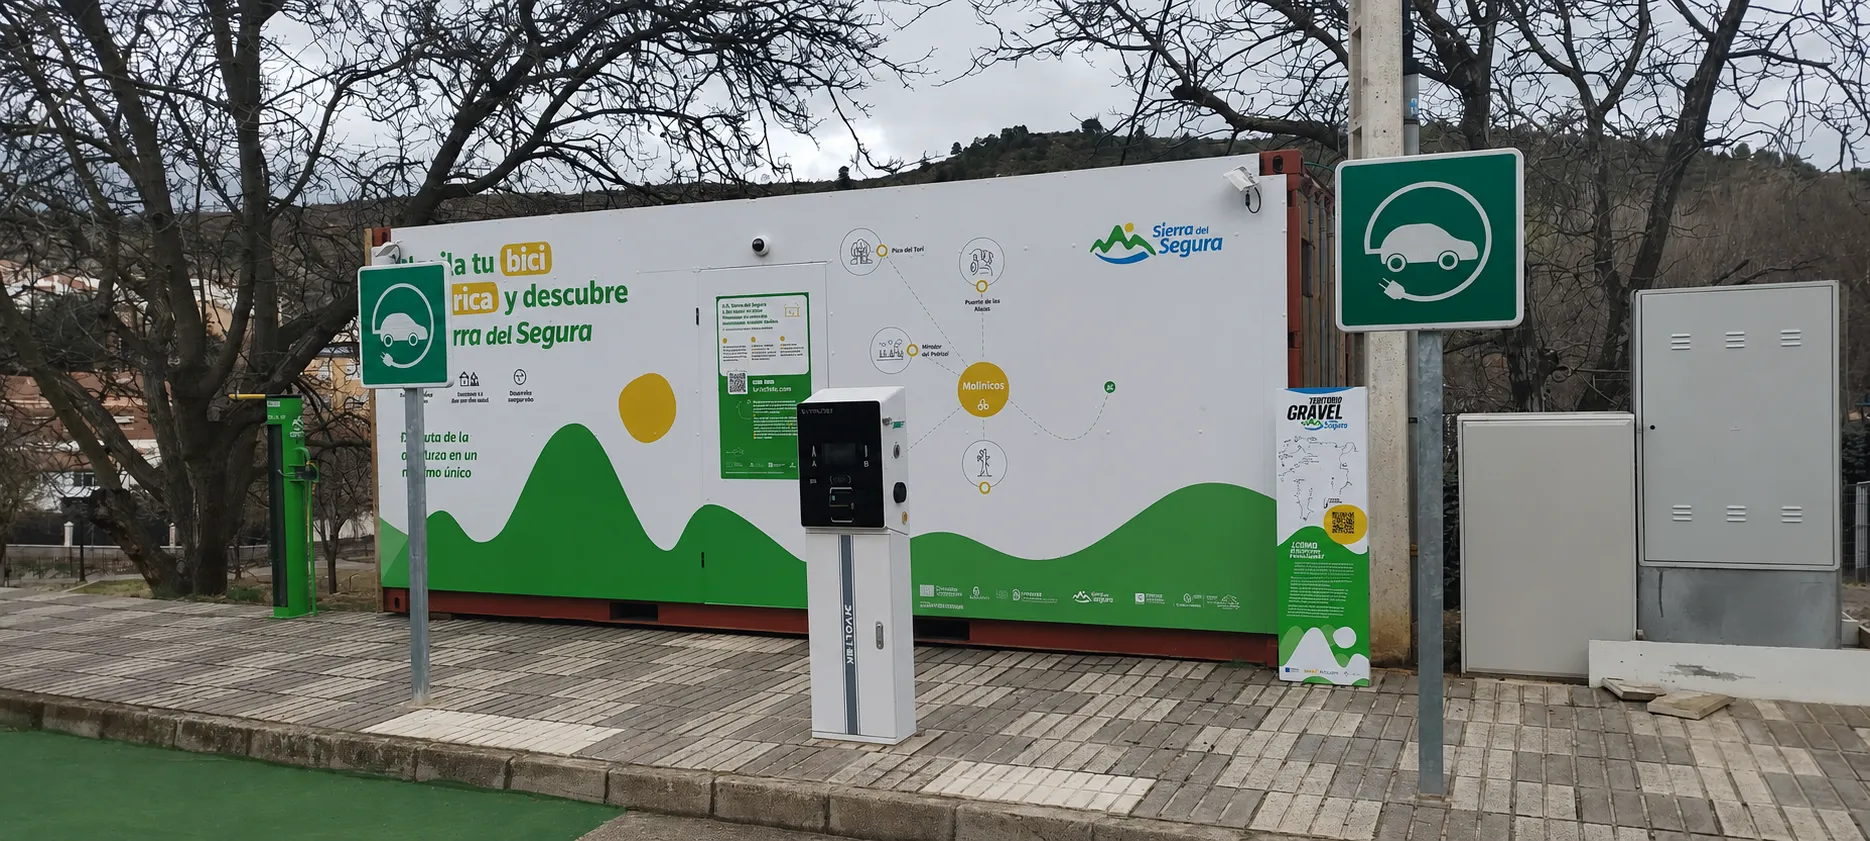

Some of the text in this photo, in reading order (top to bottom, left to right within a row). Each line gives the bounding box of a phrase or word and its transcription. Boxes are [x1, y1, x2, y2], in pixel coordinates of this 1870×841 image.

[1152, 222, 1209, 239] Sierra del
[1158, 237, 1223, 258] Segura
[472, 253, 494, 275] tu
[506, 245, 546, 273] bici
[504, 290, 518, 316] y
[522, 280, 629, 309] descubre
[486, 325, 512, 346] del
[516, 322, 592, 350] Segura
[962, 381, 1005, 391] Molinicos
[1287, 404, 1343, 420] GRAVEL
[444, 432, 456, 443] de
[459, 431, 469, 443] la
[449, 451, 461, 461] en
[465, 451, 477, 461] un
[444, 466, 472, 478] único
